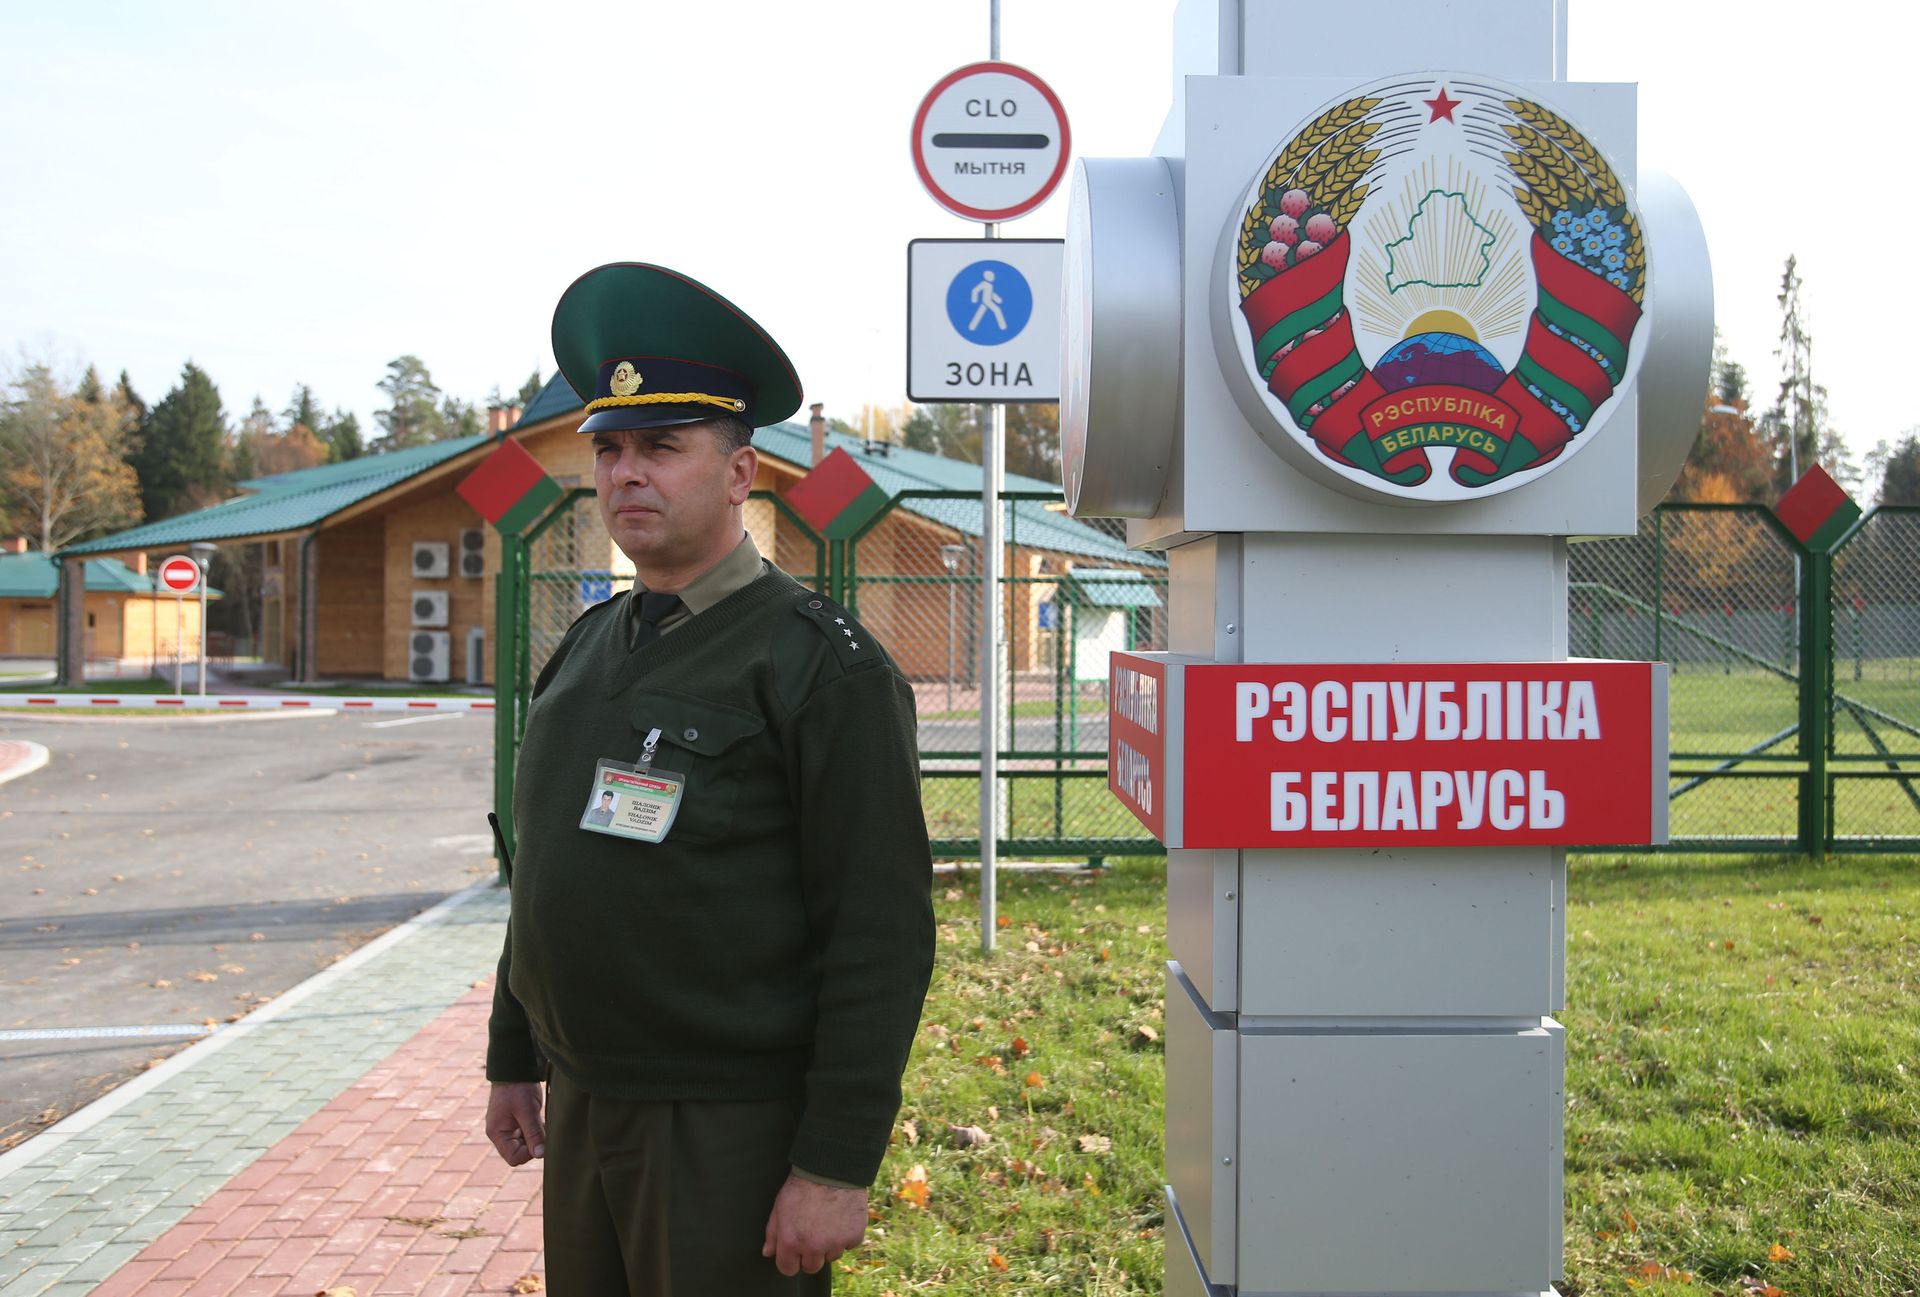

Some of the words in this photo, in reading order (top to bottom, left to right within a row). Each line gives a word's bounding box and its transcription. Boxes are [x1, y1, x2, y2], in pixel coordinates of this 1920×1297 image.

[966, 99, 1017, 118] CLO
[954, 162, 1025, 175] МЫТНЯ
[945, 362, 1033, 386] ЗОНА
[1371, 397, 1506, 429] РЭСПУБЛІКА
[1381, 426, 1496, 453] БЕЛАРУСЬ
[1235, 680, 1601, 742] РЭСПУБЛІКА
[1270, 769, 1566, 832] БЕЛАРУСЬ
